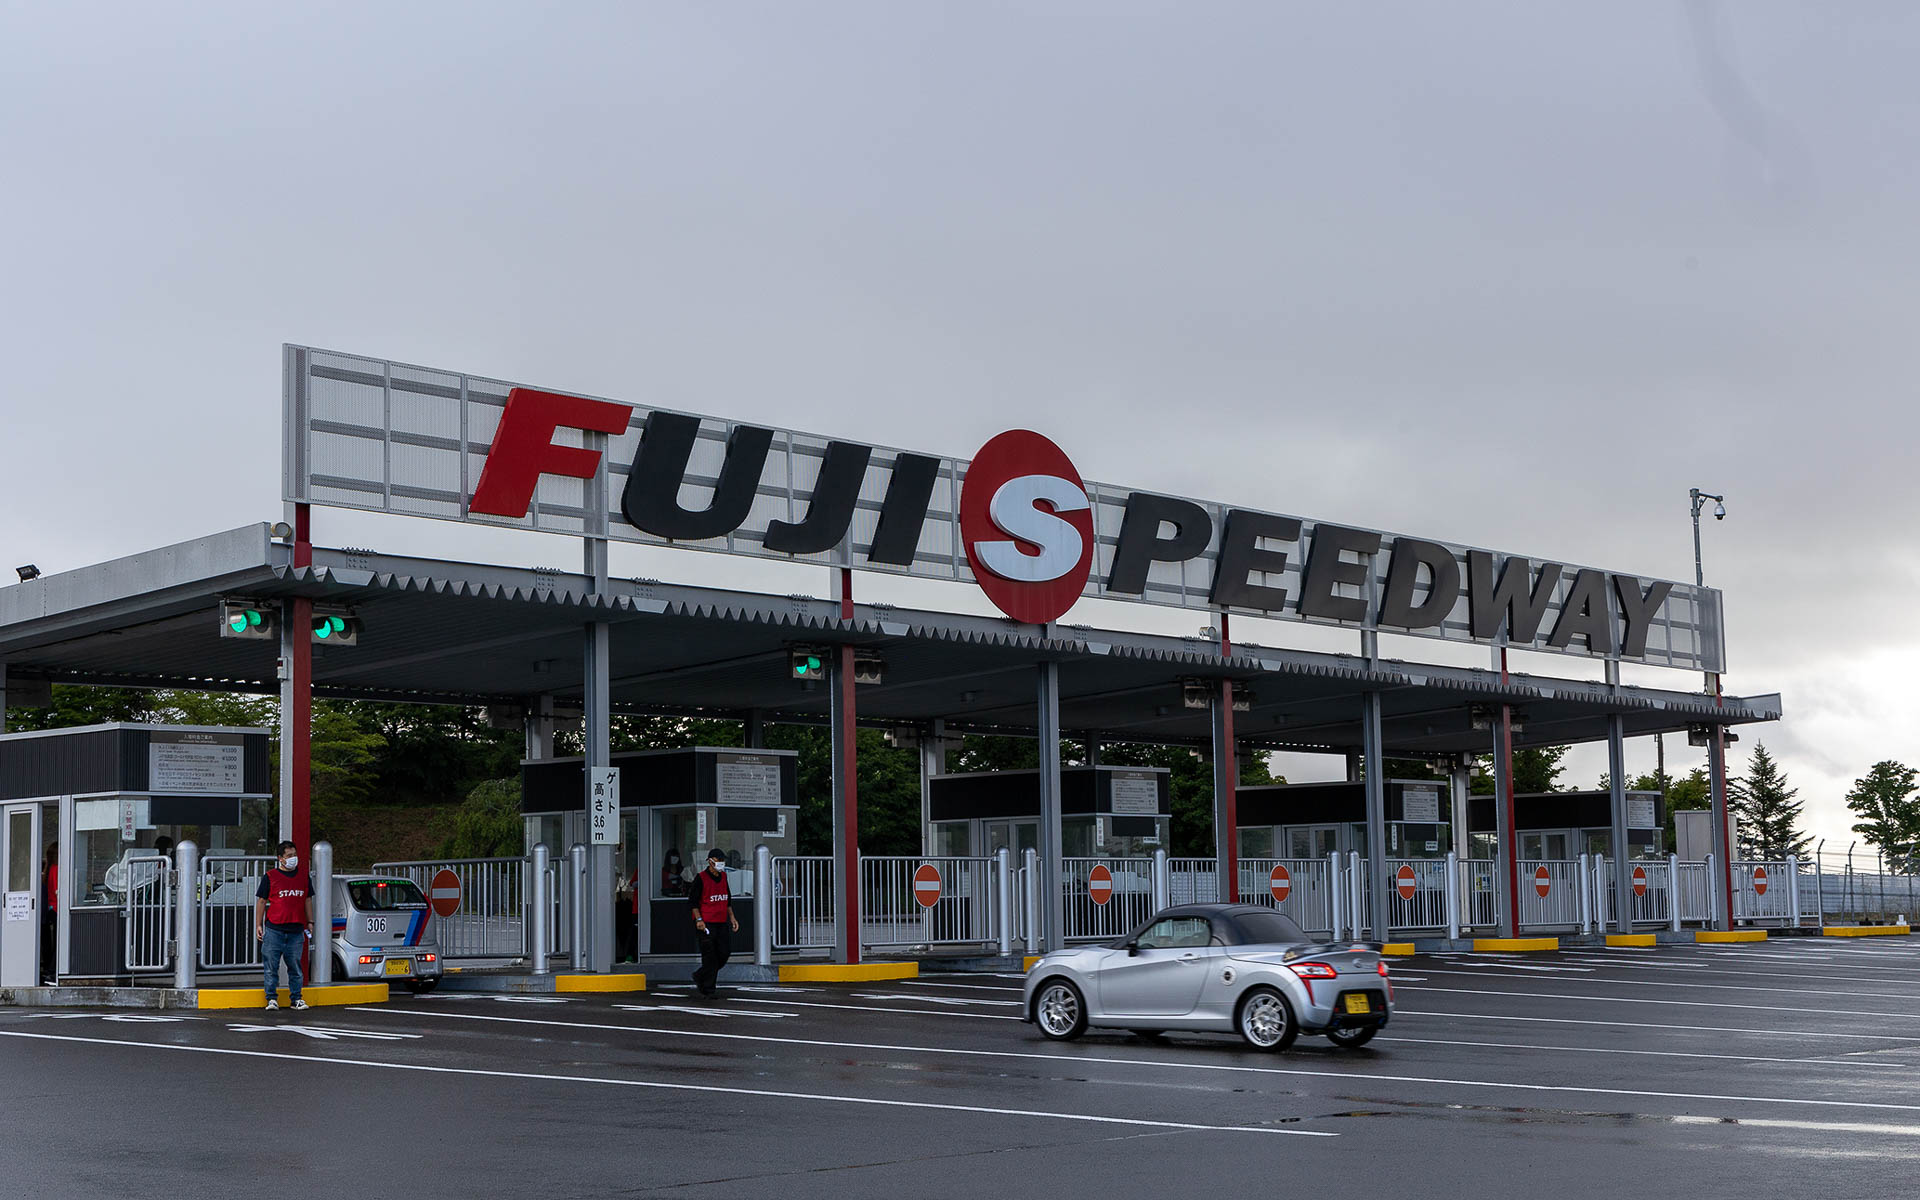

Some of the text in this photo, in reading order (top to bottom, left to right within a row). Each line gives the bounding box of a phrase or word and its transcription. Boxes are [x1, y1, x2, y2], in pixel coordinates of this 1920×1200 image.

[468, 387, 1674, 658] FUJI SPEEDWAY
[606, 771, 617, 814] ゲート
[278, 889, 304, 898] STAFF
[367, 918, 386, 932] 306
